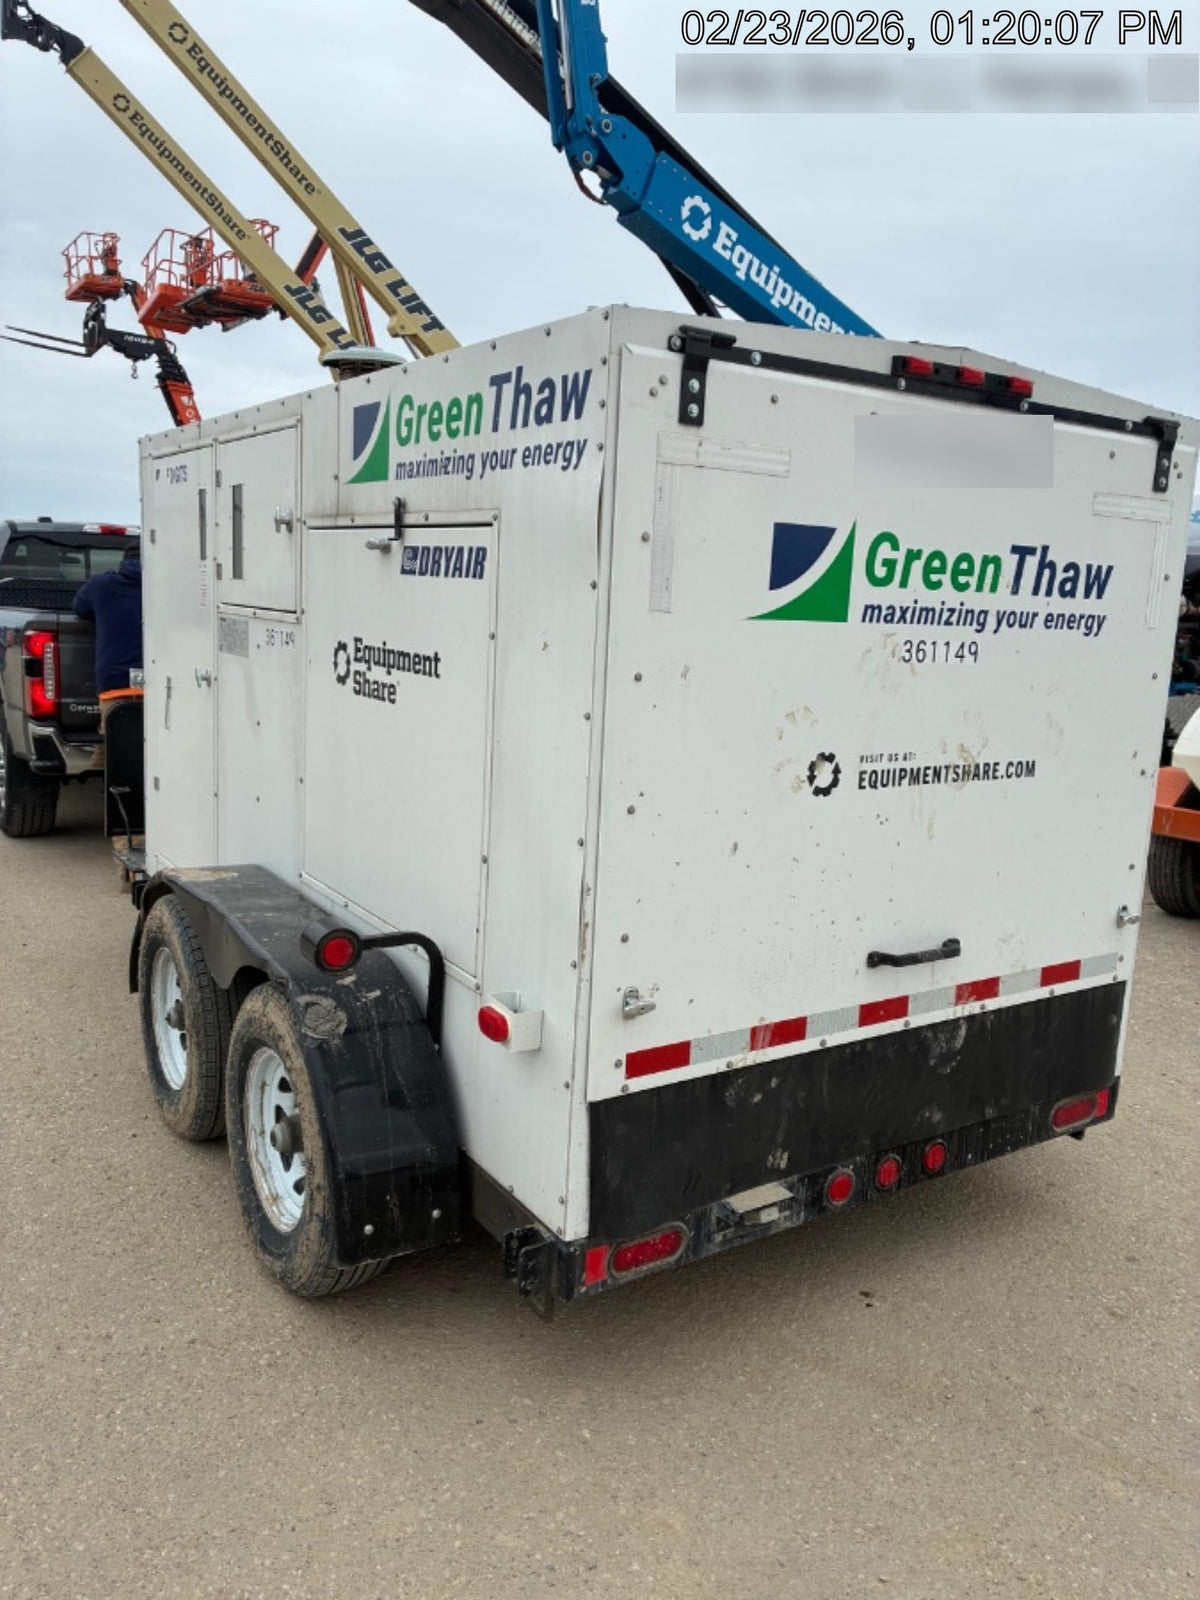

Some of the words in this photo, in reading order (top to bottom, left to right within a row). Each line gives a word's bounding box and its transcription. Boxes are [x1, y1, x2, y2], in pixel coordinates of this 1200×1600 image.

[186, 41, 316, 196] EquipmentShare
[129, 111, 247, 240] EquipmentShare
[338, 227, 393, 274] JLG
[385, 278, 445, 333] LIFT
[712, 221, 856, 336] Equipmen
[283, 284, 334, 324] JLG
[395, 450, 475, 480] maximizing
[480, 446, 517, 479] your
[522, 438, 588, 471] energy
[418, 546, 487, 580] DRYAIR
[861, 599, 989, 633] maximizing
[993, 610, 1039, 634] your
[1043, 612, 1106, 637] energy
[353, 636, 441, 679] Equipment
[901, 639, 979, 663] 361149
[353, 670, 397, 704] Share
[857, 760, 1036, 790] EQUIPMENTSHARE.COM
